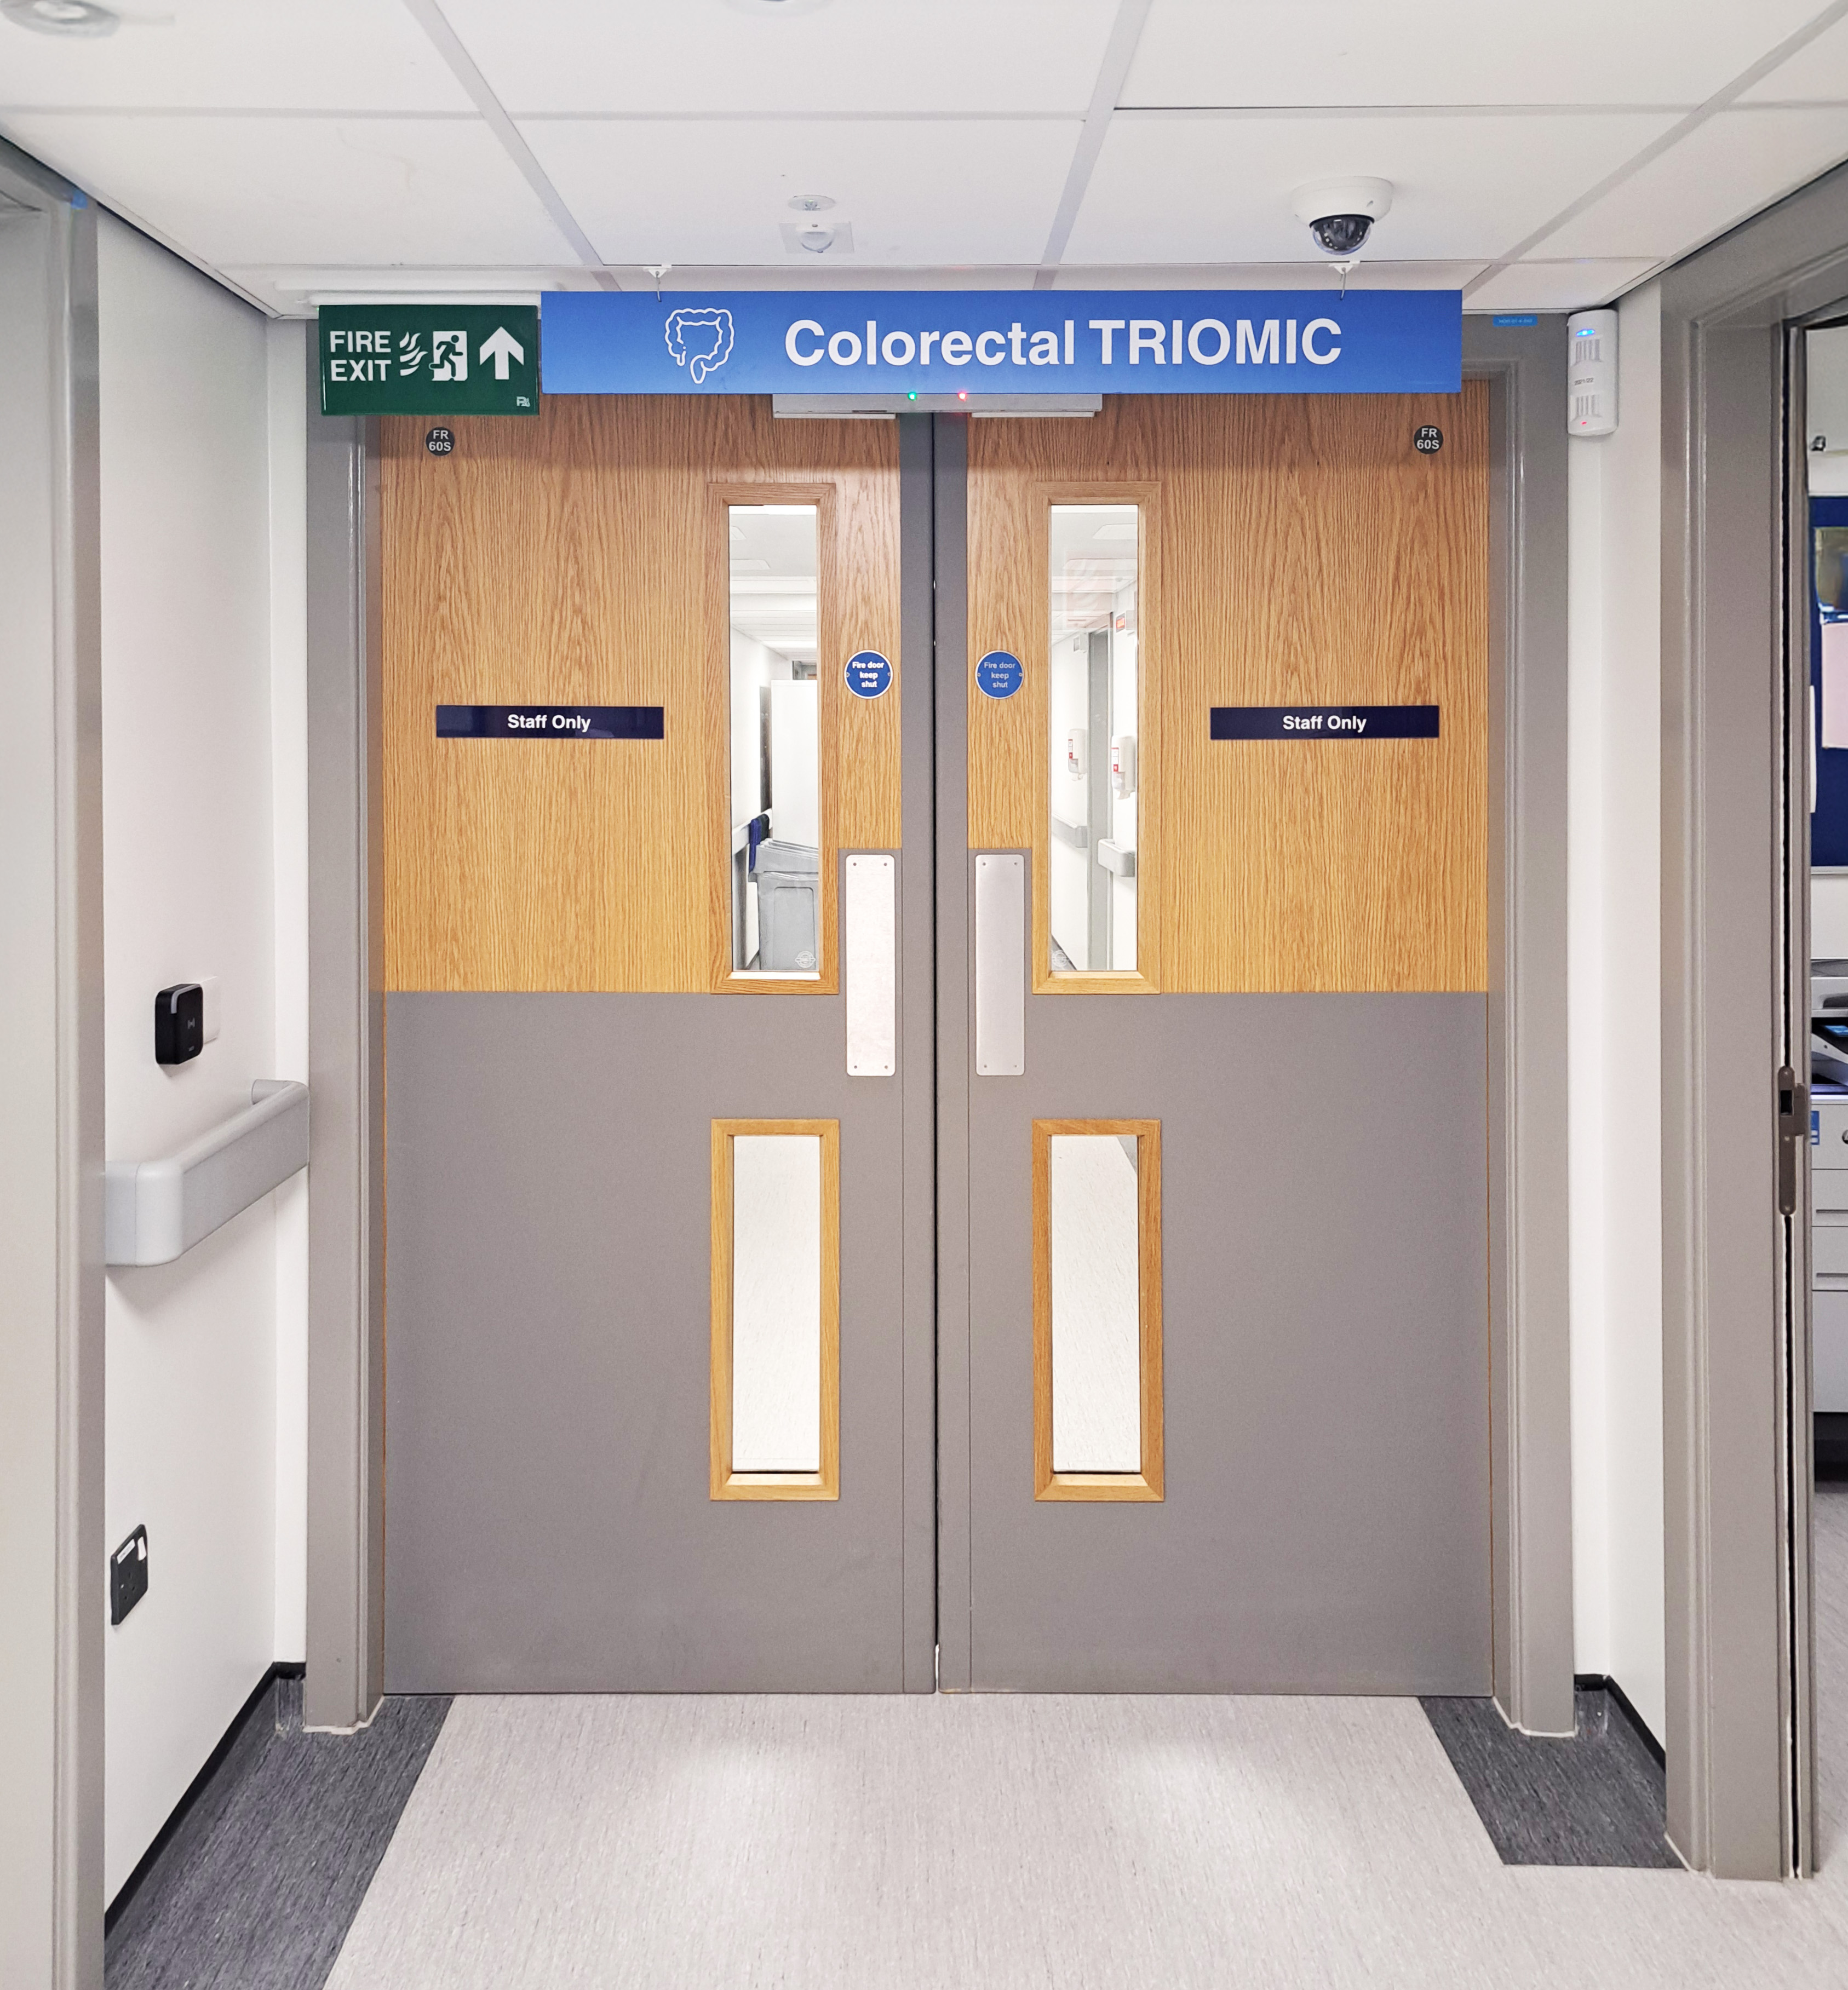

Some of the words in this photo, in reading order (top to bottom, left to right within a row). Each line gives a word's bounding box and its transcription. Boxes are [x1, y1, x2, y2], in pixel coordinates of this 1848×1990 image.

[330, 331, 391, 352] FIRE
[785, 320, 1074, 366] Colorectal
[1089, 318, 1341, 365] TRIOMIC
[331, 360, 391, 381] EXIT
[433, 430, 448, 439] FR
[1422, 428, 1437, 438] FR
[429, 442, 451, 451] 60S
[1417, 440, 1439, 449] 60S
[860, 671, 878, 680] keep
[508, 715, 547, 728] Staff
[552, 715, 590, 732] Only
[1283, 716, 1322, 729] Staff
[1328, 715, 1367, 733] Only
